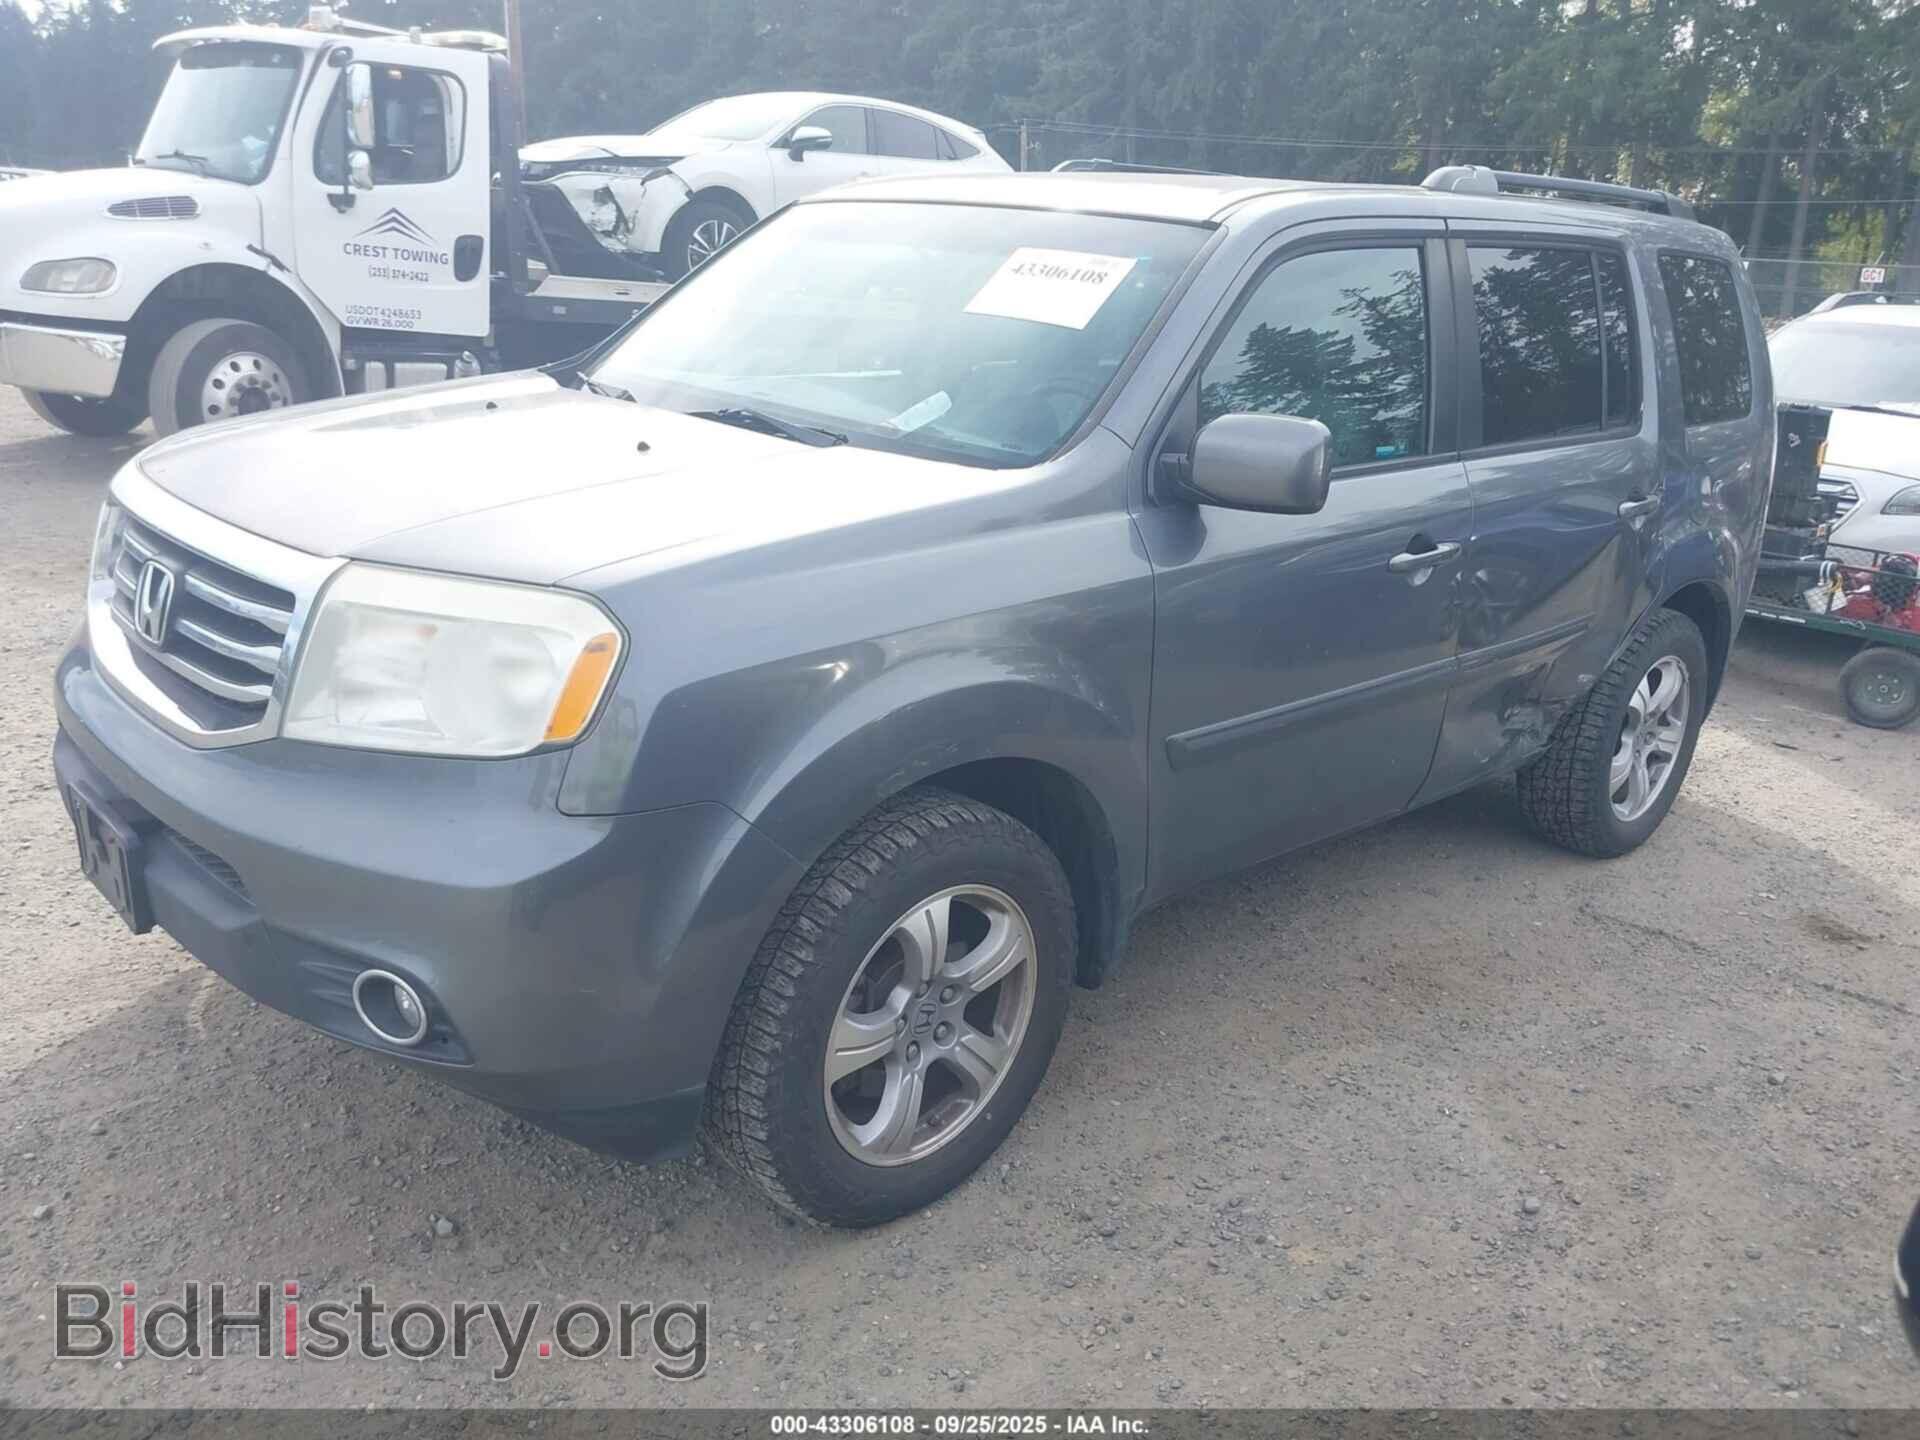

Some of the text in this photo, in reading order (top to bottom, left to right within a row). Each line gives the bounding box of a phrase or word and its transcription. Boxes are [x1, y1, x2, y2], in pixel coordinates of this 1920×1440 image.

[343, 243, 449, 265] CREST TOWING
[1012, 263, 1108, 285] 43306108
[345, 305, 378, 316] USDOT
[346, 315, 380, 327] GVWR
